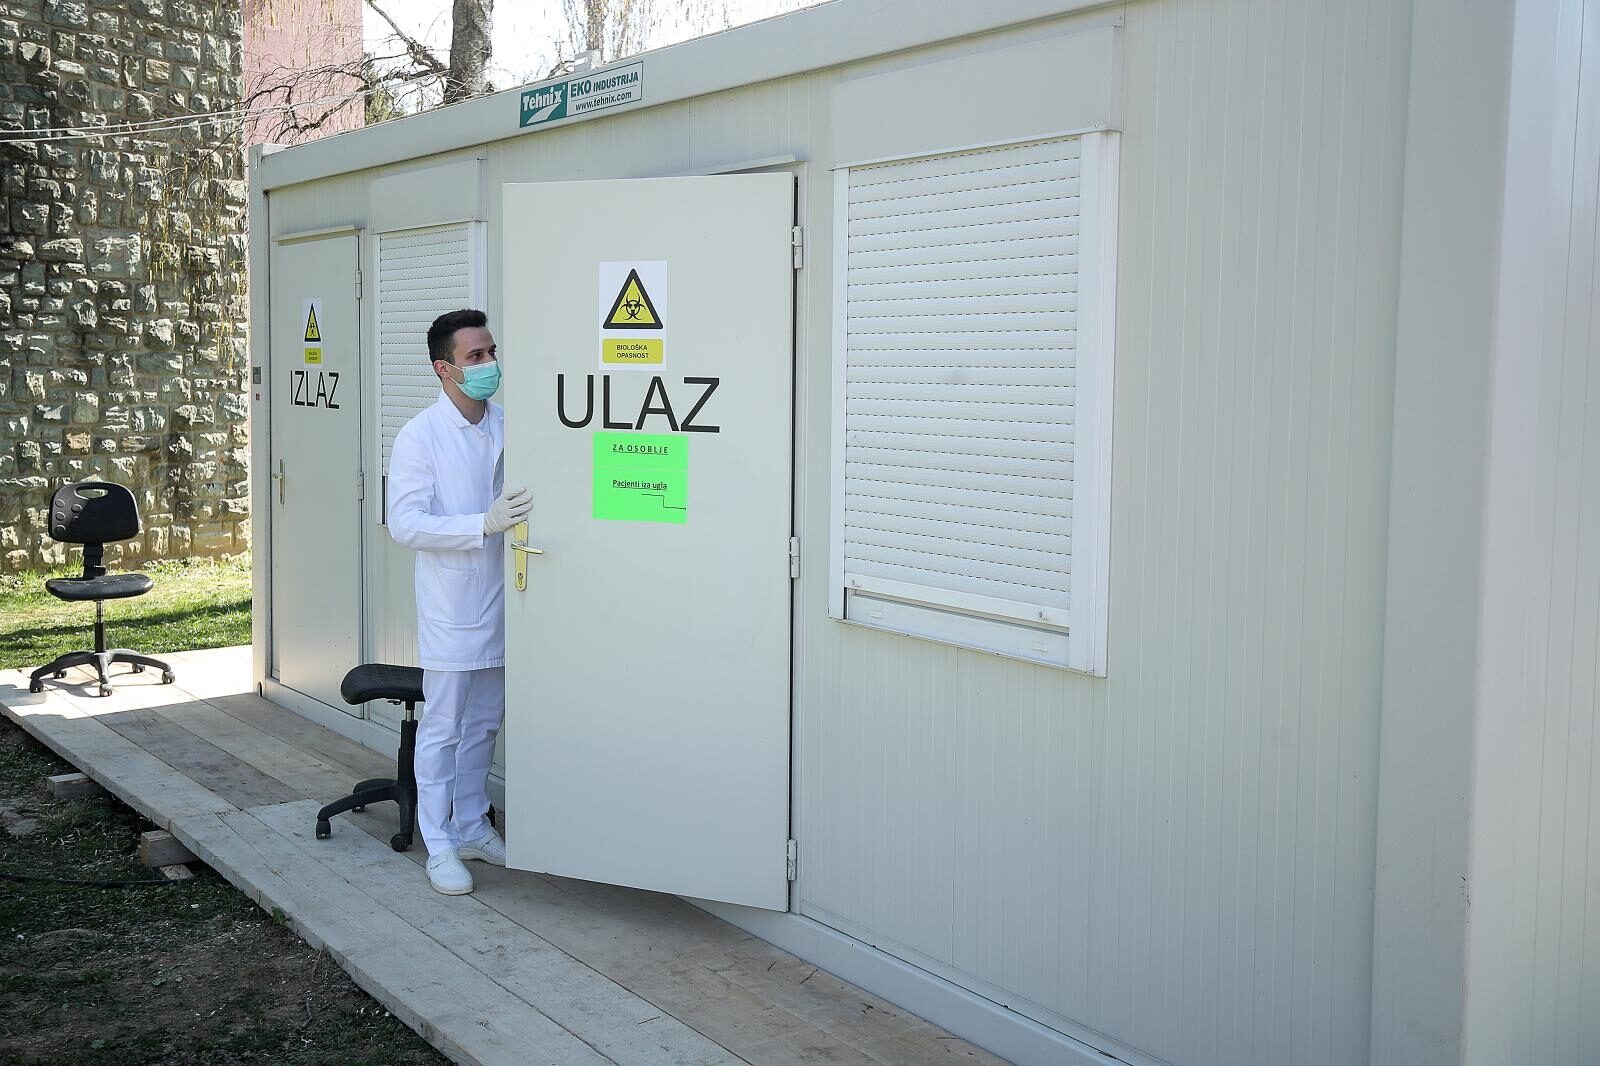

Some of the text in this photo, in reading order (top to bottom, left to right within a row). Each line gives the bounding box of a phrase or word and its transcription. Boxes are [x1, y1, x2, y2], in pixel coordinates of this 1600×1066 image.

[570, 71, 639, 98] EKO INDUSTRIJA
[522, 87, 563, 112] Tehnix
[575, 90, 632, 111] www.tehnix.com
[616, 343, 648, 351] BIOLOŠKA
[290, 370, 340, 409] IZLAZ
[557, 373, 720, 433] ULAZ
[627, 444, 669, 454] OSOBLJE
[612, 479, 667, 490] Pacjenti iza ugla
